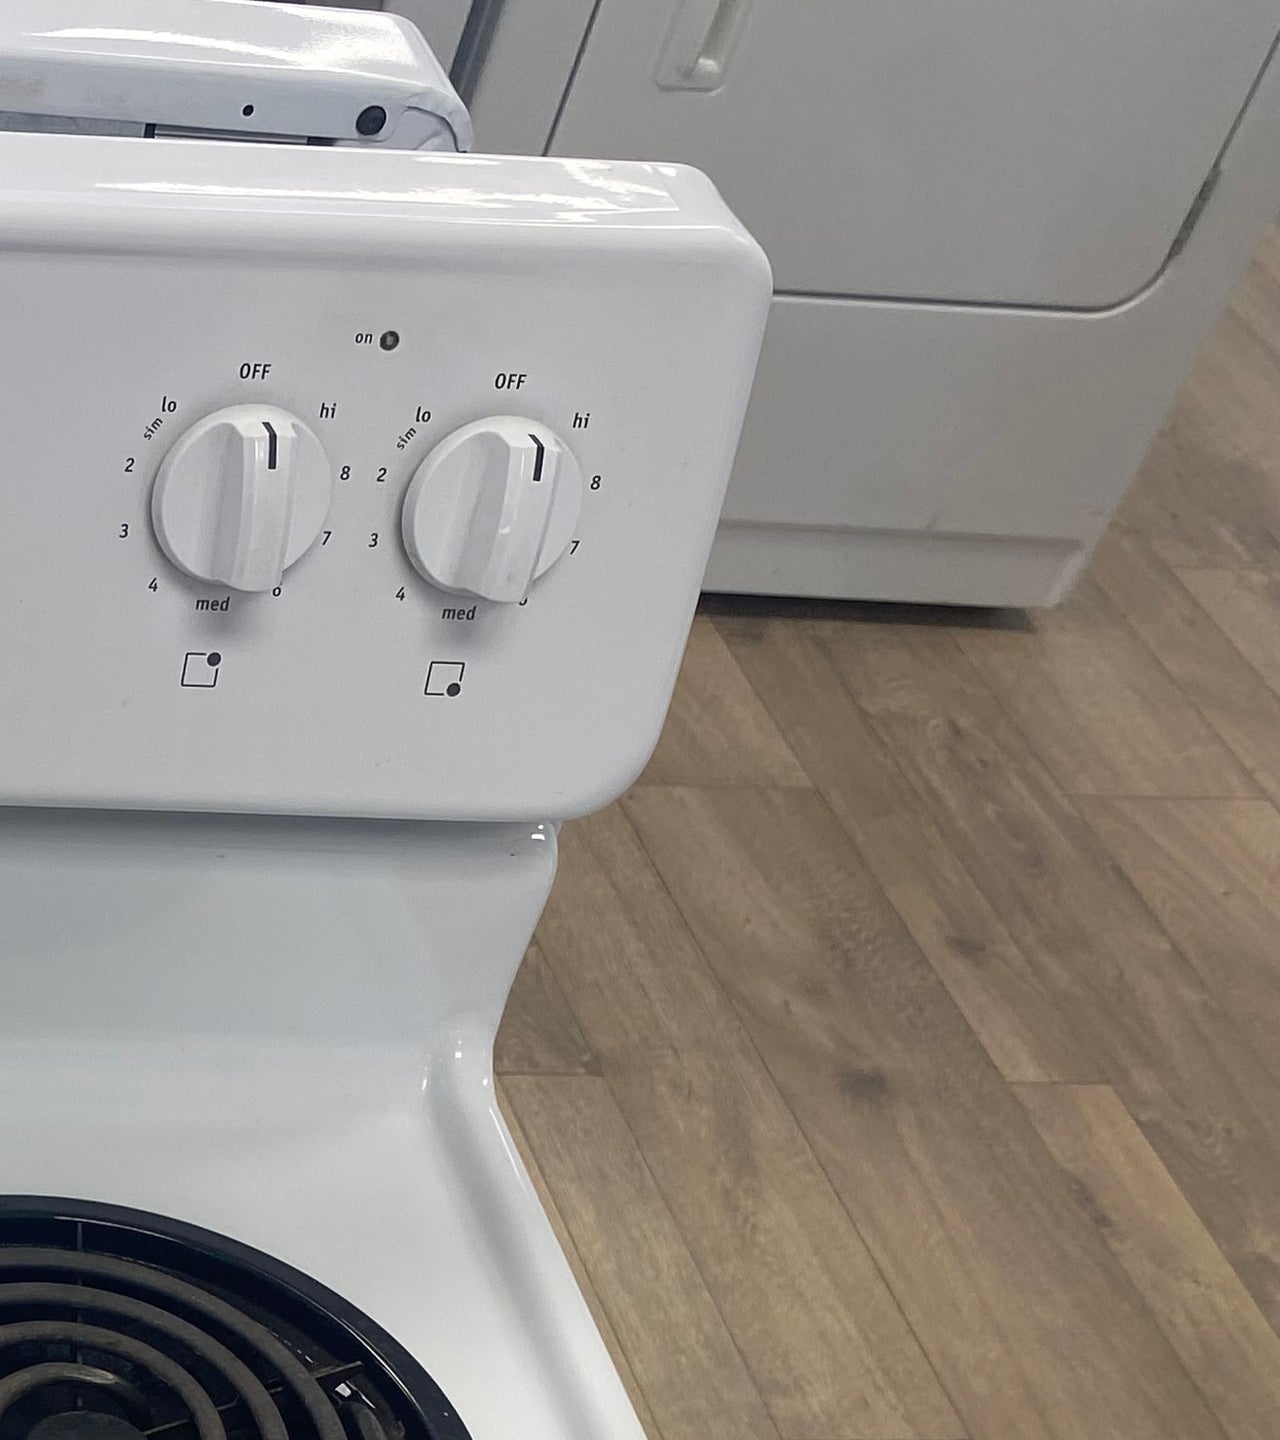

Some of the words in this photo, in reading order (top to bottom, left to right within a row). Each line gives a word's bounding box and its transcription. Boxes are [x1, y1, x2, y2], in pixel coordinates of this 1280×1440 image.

[355, 332, 373, 344] on
[239, 362, 272, 380] OFF
[494, 372, 528, 390] OFF
[161, 395, 177, 413] lo
[319, 402, 337, 419] hi
[415, 406, 431, 423] lo
[572, 412, 591, 429] hi
[143, 417, 164, 441] sim
[396, 427, 417, 450] sim
[124, 457, 135, 473] 2
[339, 465, 351, 481] 8
[376, 467, 387, 483] 2
[590, 475, 602, 491] 8
[118, 523, 129, 539] 3
[322, 530, 332, 546] 7
[368, 532, 379, 548] 3
[569, 540, 580, 555] 7
[148, 577, 158, 593] 4
[395, 586, 405, 602] 4
[195, 596, 231, 612] med
[441, 605, 477, 621] med
